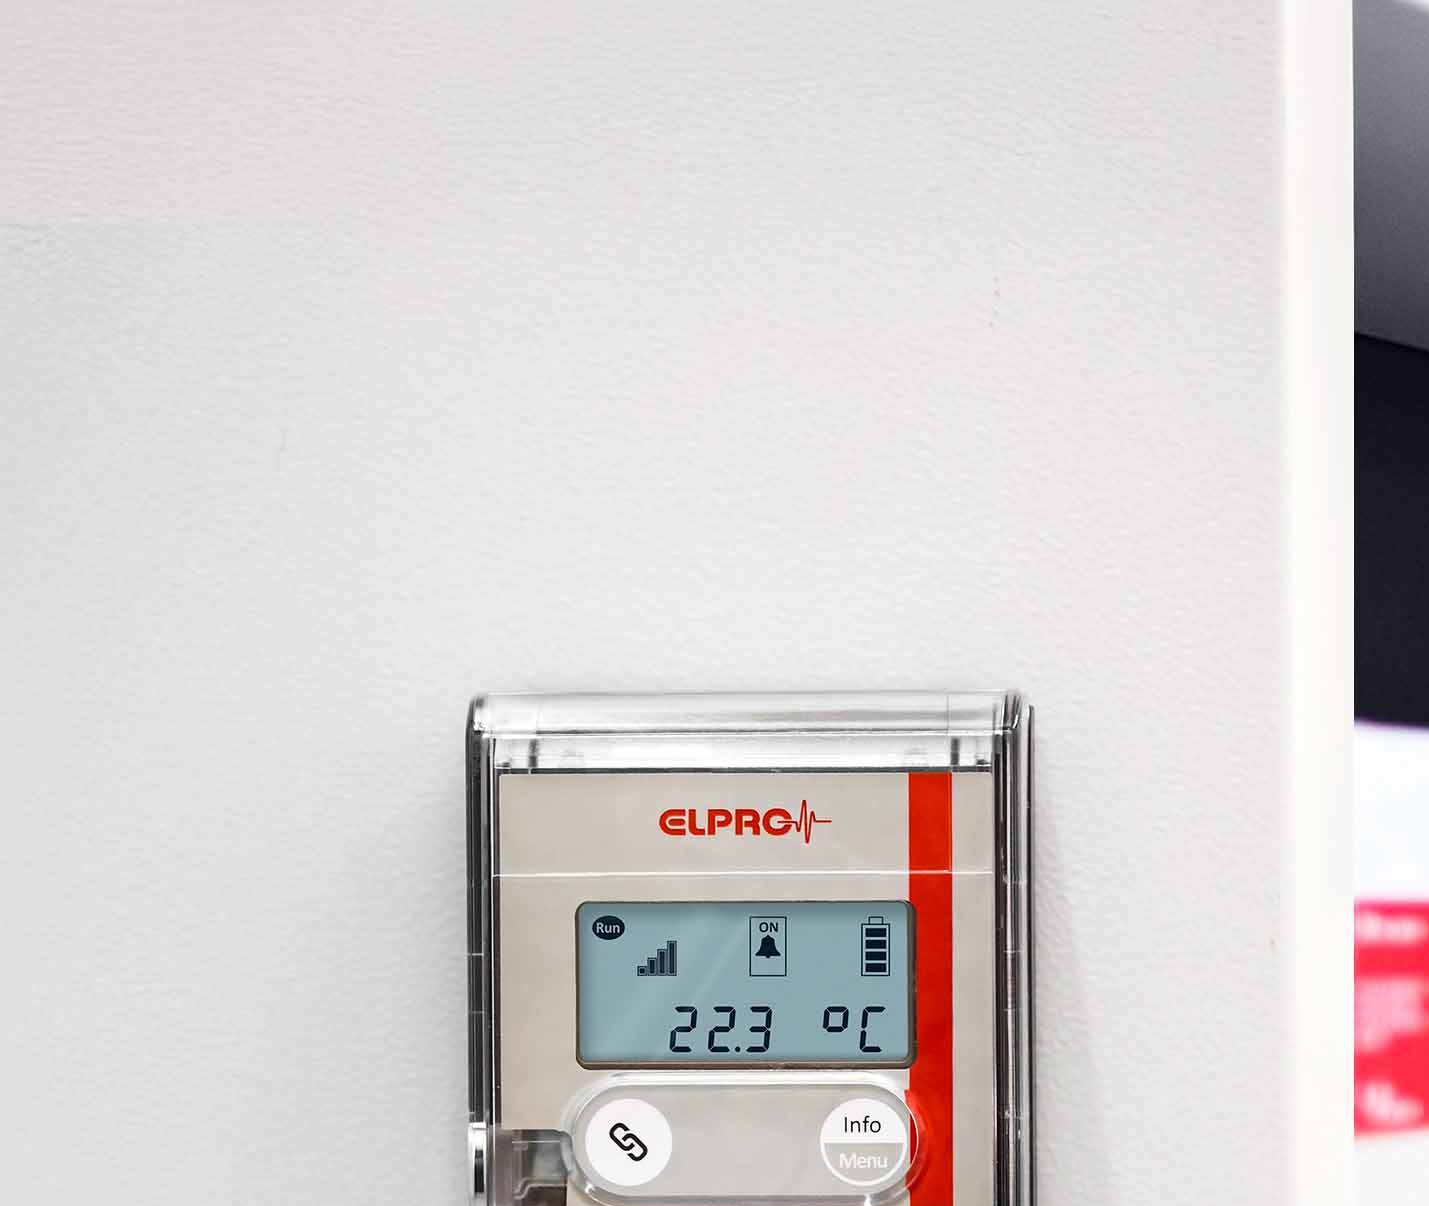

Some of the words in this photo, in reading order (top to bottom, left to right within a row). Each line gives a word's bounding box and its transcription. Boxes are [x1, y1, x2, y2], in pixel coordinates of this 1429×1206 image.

[658, 807, 794, 837] ELPRO
[595, 921, 622, 935] Run
[758, 921, 780, 934] ON
[669, 1006, 773, 1053] 22.3
[844, 1115, 882, 1134] Info
[839, 1151, 889, 1169] Menu
